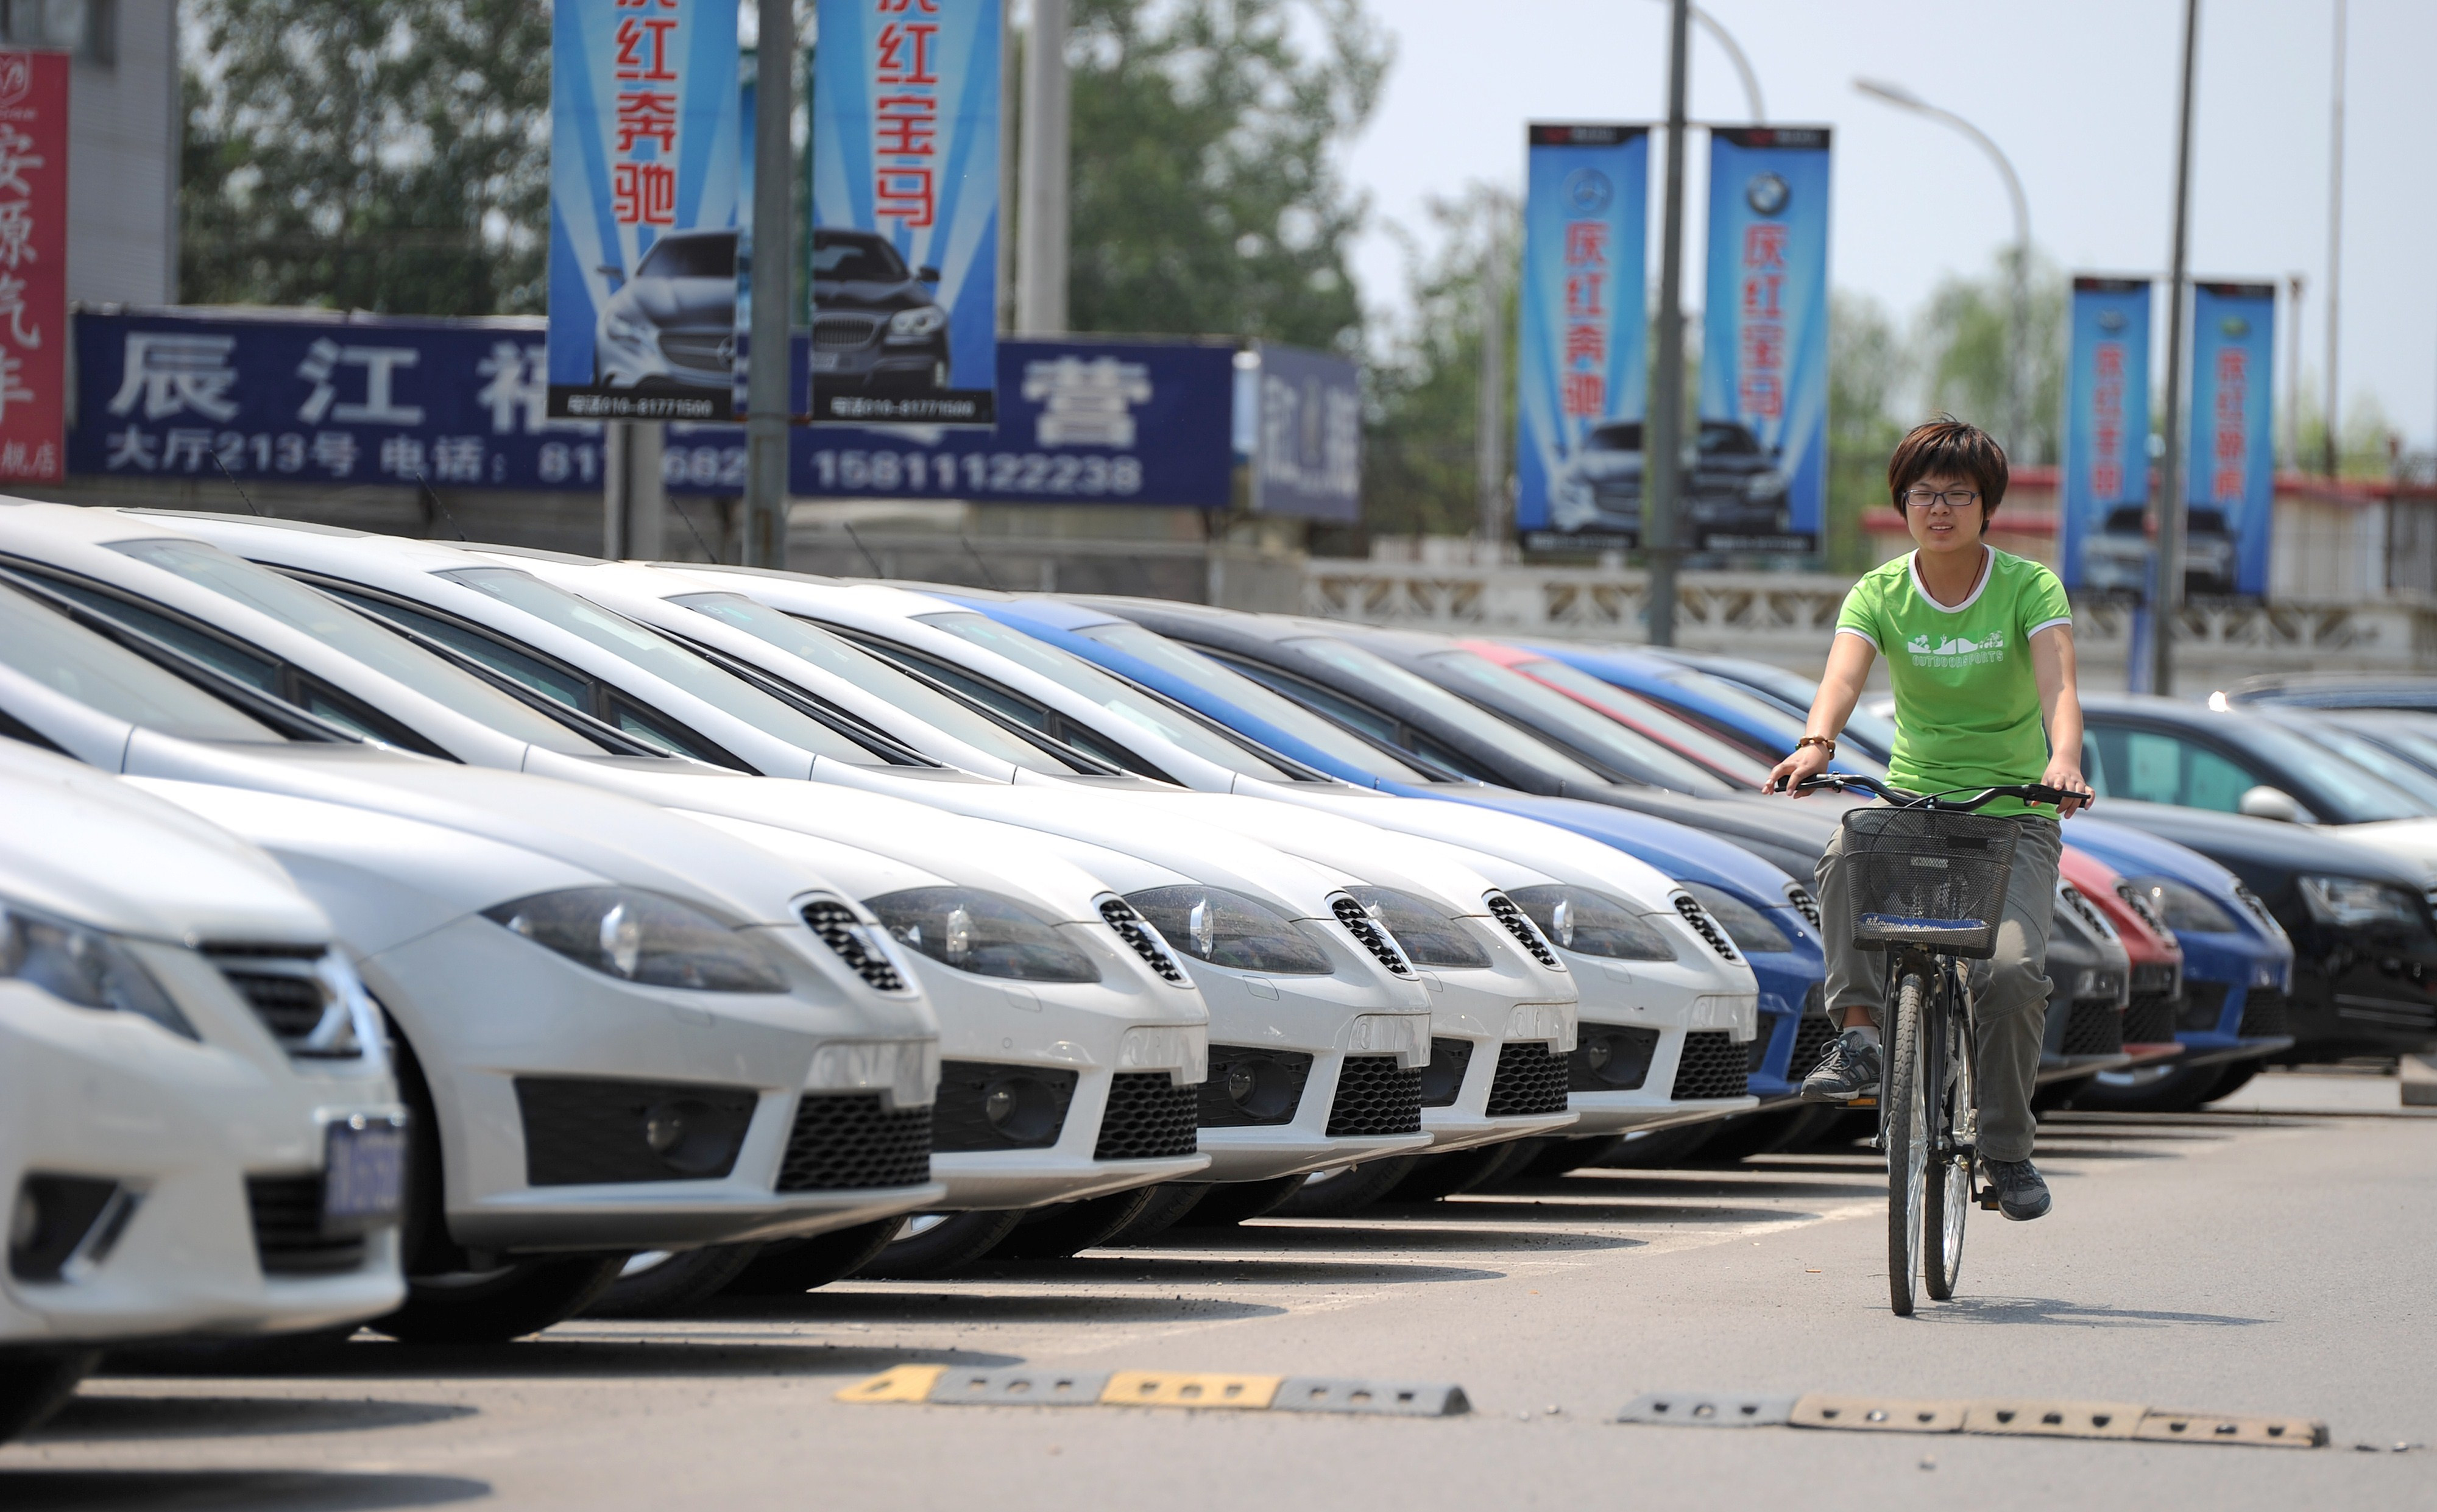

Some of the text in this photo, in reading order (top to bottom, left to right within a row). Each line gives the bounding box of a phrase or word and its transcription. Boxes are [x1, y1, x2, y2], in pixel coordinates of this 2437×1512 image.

[614, 0, 678, 225] 红奔驰
[876, 0, 940, 228] 红宝马
[1562, 221, 1610, 417] 庆红奔驰
[1739, 223, 1789, 421] 庆红宝马
[1912, 650, 2004, 668] OUTDOORSPORTS
